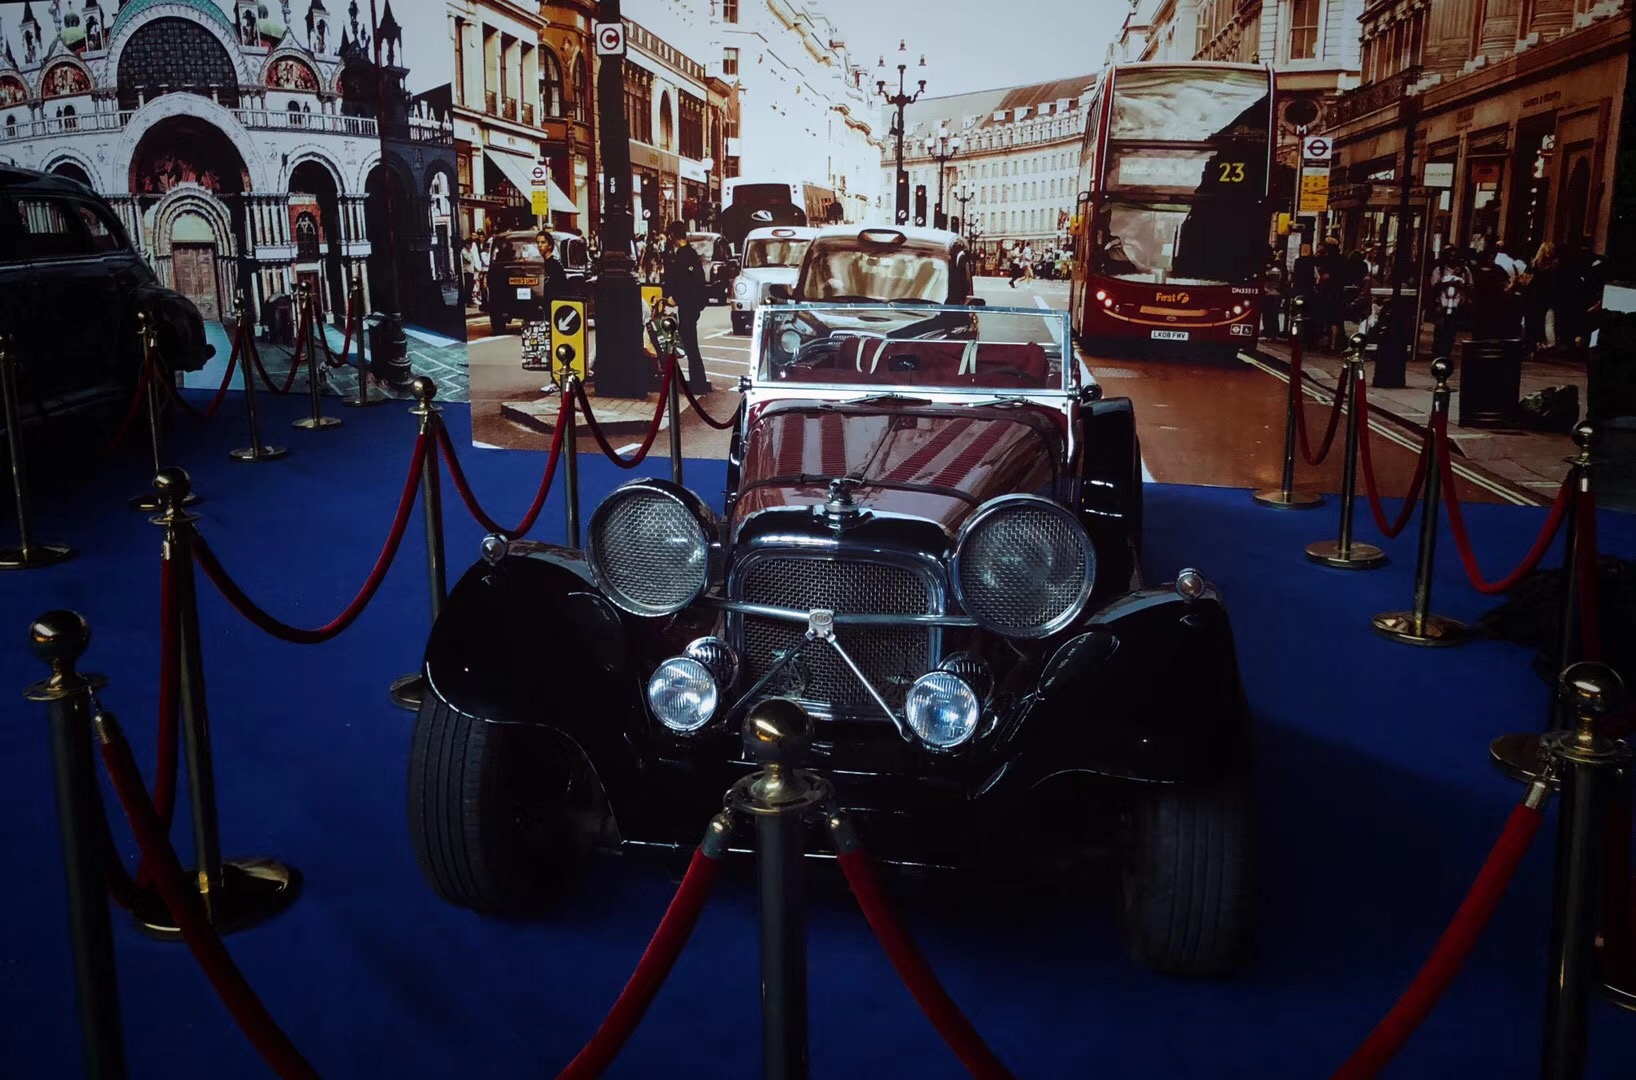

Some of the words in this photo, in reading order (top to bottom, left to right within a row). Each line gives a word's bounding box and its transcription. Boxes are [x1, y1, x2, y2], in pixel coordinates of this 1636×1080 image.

[601, 29, 619, 49] C
[1296, 125, 1307, 135] M
[1218, 162, 1245, 182] 23
[1155, 292, 1177, 303] First
